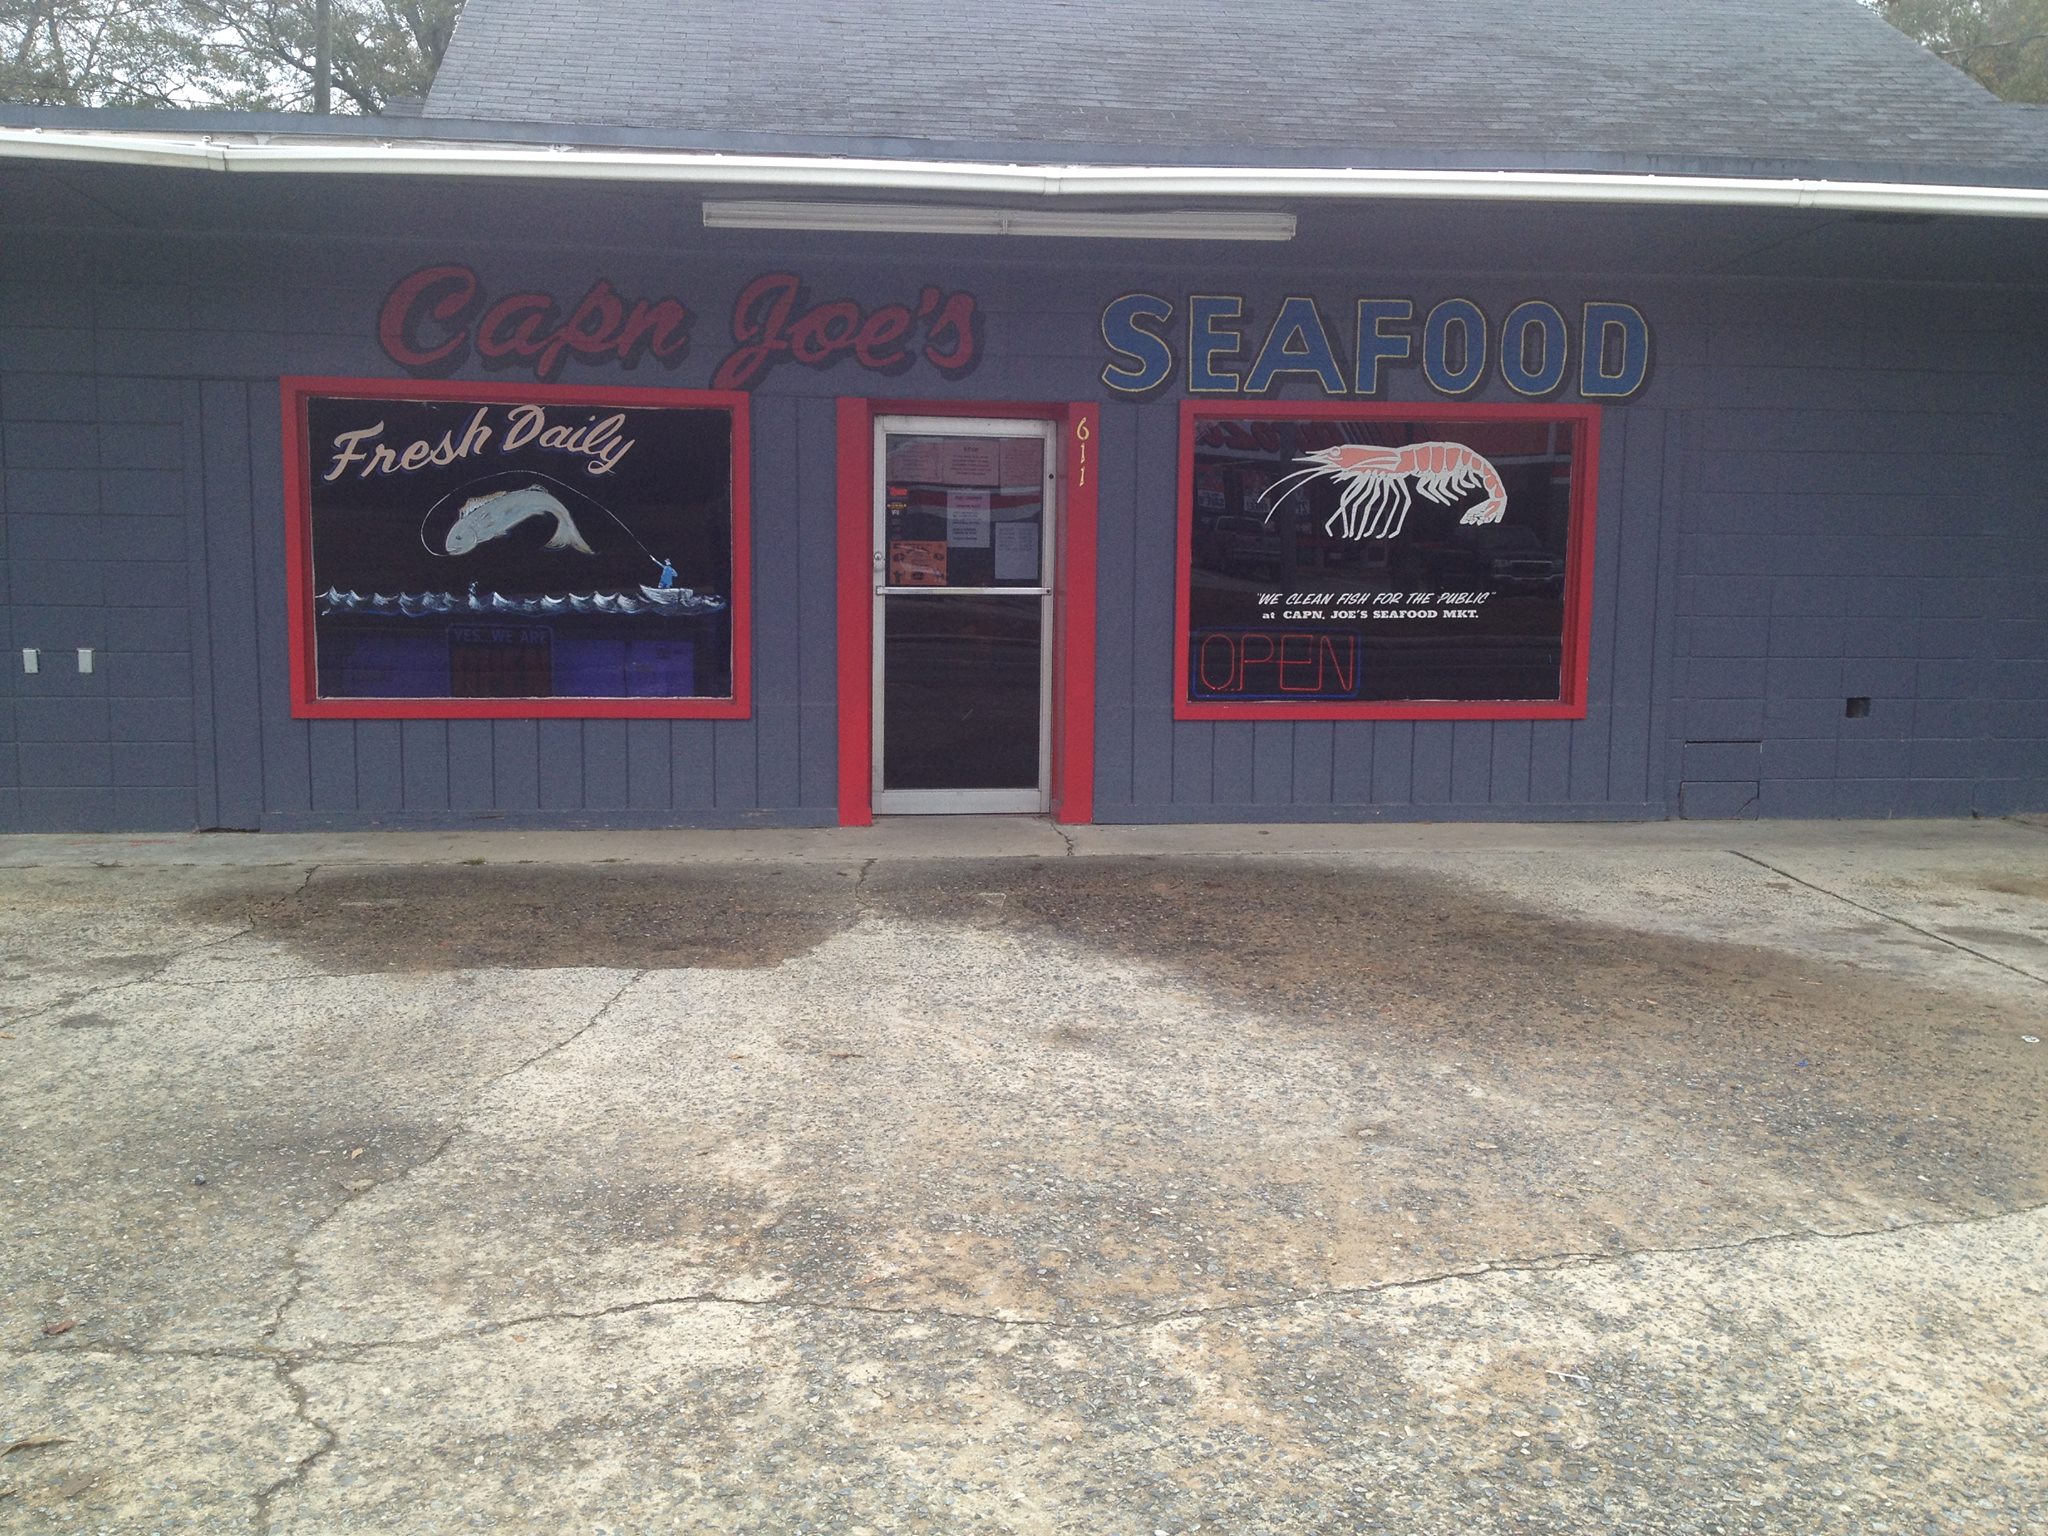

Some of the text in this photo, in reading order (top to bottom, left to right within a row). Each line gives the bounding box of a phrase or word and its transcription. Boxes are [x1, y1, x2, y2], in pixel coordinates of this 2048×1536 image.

[378, 264, 981, 390] Capn Joe's
[1101, 294, 1650, 397] SEAFOOD
[323, 404, 636, 481] Fresh Daily
[1262, 611, 1276, 620] at
[1330, 609, 1369, 620] JOE'S
[1373, 609, 1438, 619] SEAFOOD
[1443, 609, 1479, 619] MKT.
[1285, 592, 1335, 606] CLEAN
[1336, 592, 1371, 606] FISH
[1372, 592, 1403, 605] FOR
[1406, 592, 1435, 605] THE
[1201, 633, 1355, 692] OPEN
